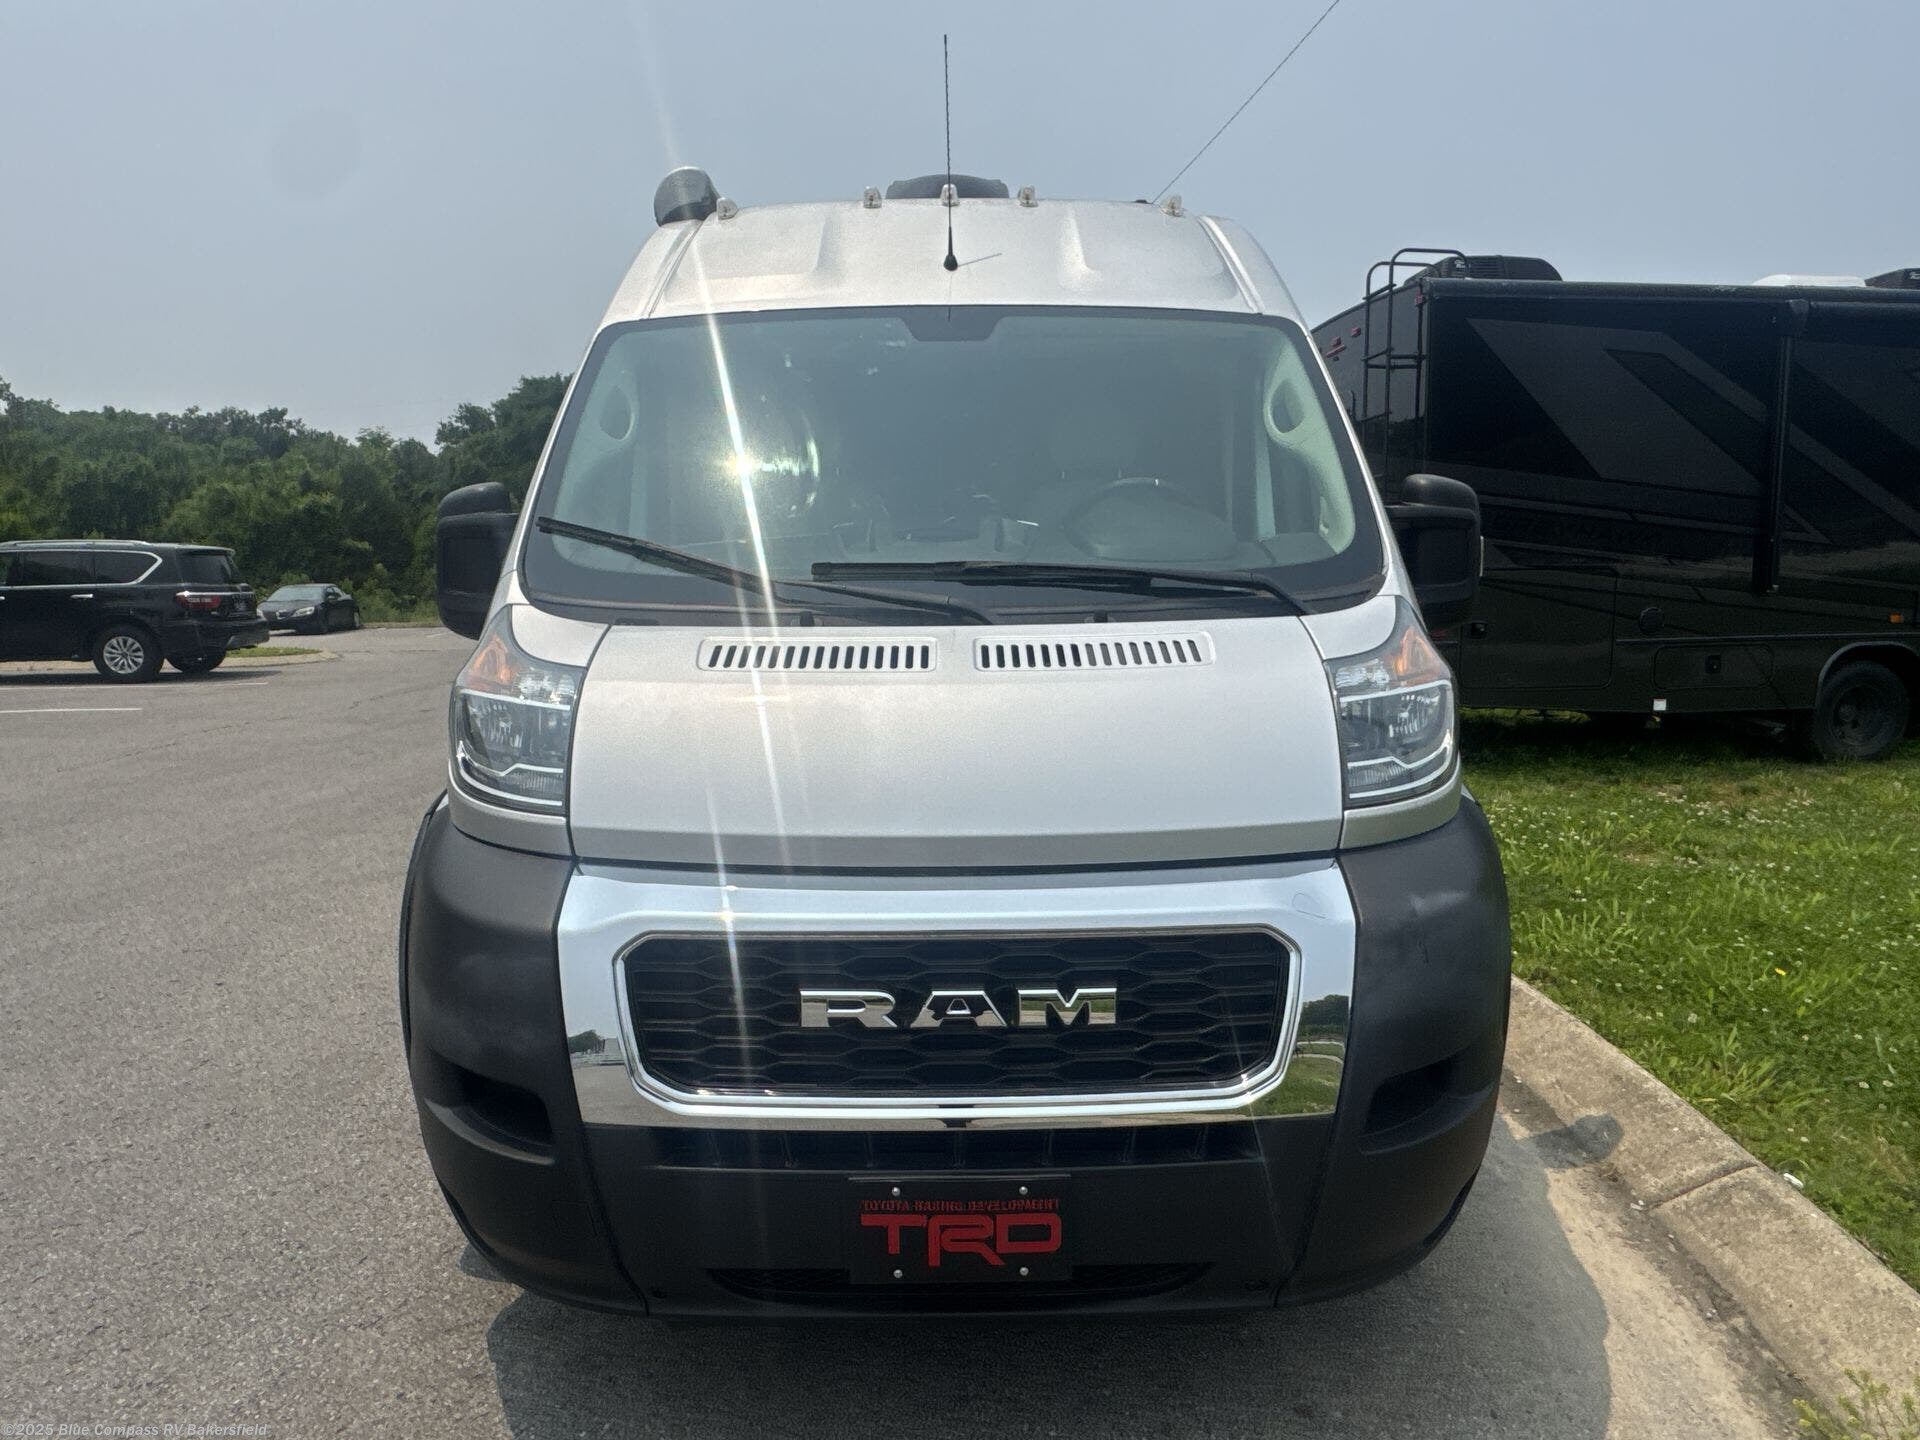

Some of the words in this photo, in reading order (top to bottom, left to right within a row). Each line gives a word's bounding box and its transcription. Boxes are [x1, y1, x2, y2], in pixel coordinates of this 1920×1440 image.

[800, 988, 1117, 1028] RAM
[862, 1200, 909, 1211] TOYOTA
[914, 1200, 963, 1212] RACING
[968, 1199, 1059, 1211] DEVELOPMENT
[861, 1213, 1062, 1267] TRD
